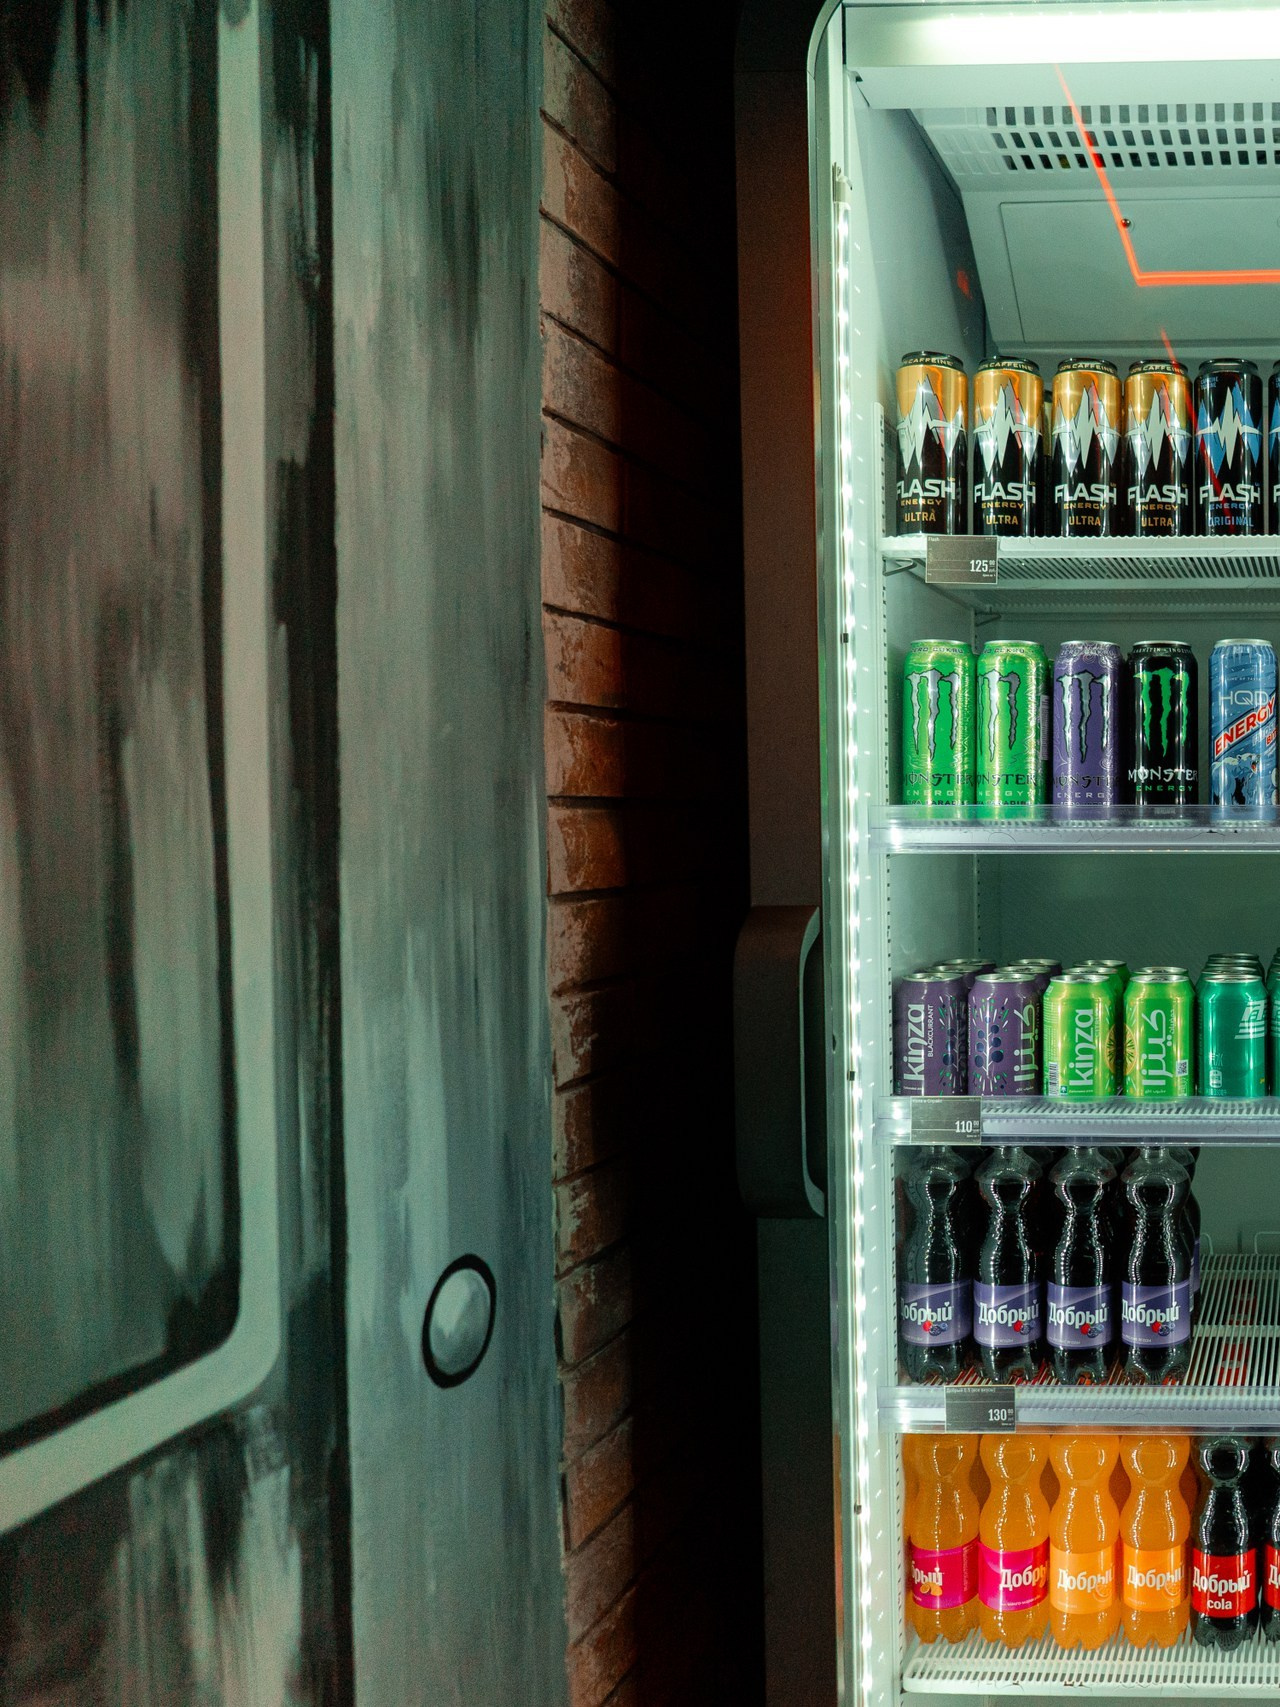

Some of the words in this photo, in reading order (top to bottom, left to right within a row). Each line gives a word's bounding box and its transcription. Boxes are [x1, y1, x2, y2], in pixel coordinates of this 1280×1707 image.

[896, 478, 956, 500] FLASH
[974, 481, 1037, 504] FLASH
[1054, 482, 1117, 506] FLASH
[1127, 484, 1189, 506] FLASH
[1199, 482, 1261, 505] FLASH
[900, 498, 942, 507] ENERGY
[981, 501, 1025, 509] ENERGY
[1063, 502, 1107, 510] ENERGY
[1136, 504, 1179, 512] ENERGY
[1210, 502, 1253, 510] ENERGY
[904, 511, 936, 523] ULTRA
[986, 514, 1019, 525] ULTRA
[1069, 515, 1101, 526] ULTRA
[1141, 516, 1174, 527] ULTRA
[1208, 515, 1254, 527] ORIGINAL
[970, 559, 988, 572] 125
[1218, 690, 1269, 706] HQD
[1213, 693, 1276, 757] ENERGY
[1127, 765, 1198, 783] MONSTER
[903, 1003, 927, 1081] kinza
[1068, 1008, 1096, 1086] kinza
[1141, 1009, 1173, 1086] كينزا
[955, 1120, 973, 1133] 110
[978, 1299, 1040, 1327] Добрый
[1048, 1301, 1109, 1329] Добрый
[1121, 1299, 1181, 1327] Добрый
[988, 1408, 1007, 1421] 130
[1193, 1566, 1252, 1597] Добрый
[1207, 1598, 1233, 1610] cola
